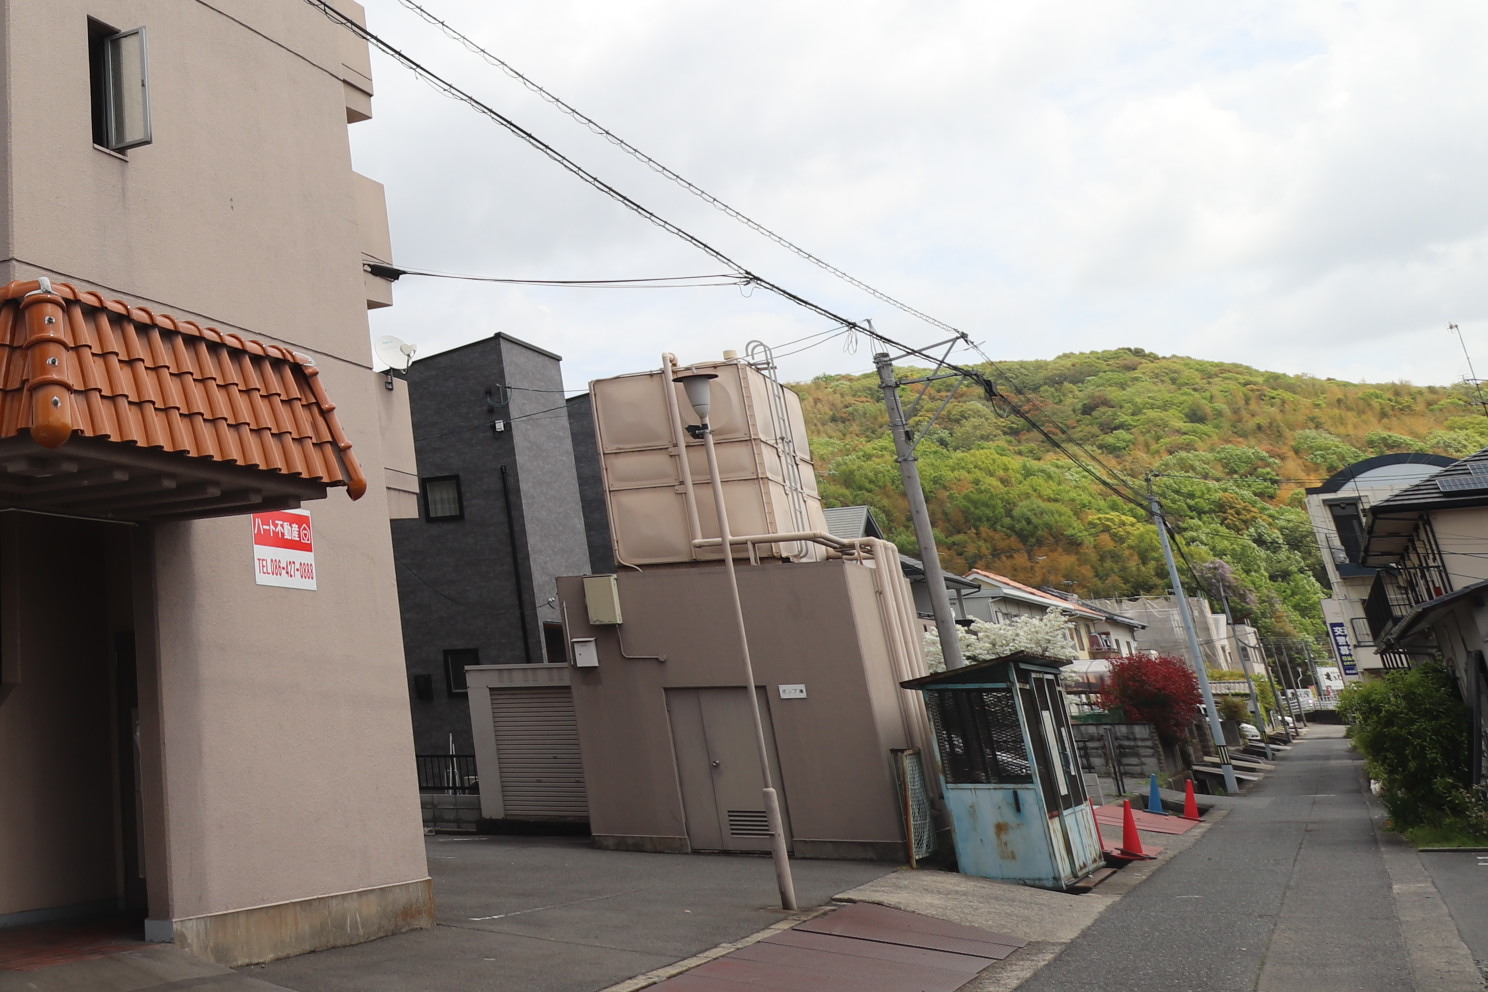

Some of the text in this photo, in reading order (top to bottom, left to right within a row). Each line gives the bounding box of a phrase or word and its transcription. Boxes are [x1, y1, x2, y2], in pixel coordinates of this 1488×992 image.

[254, 518, 300, 541] ハート不動産
